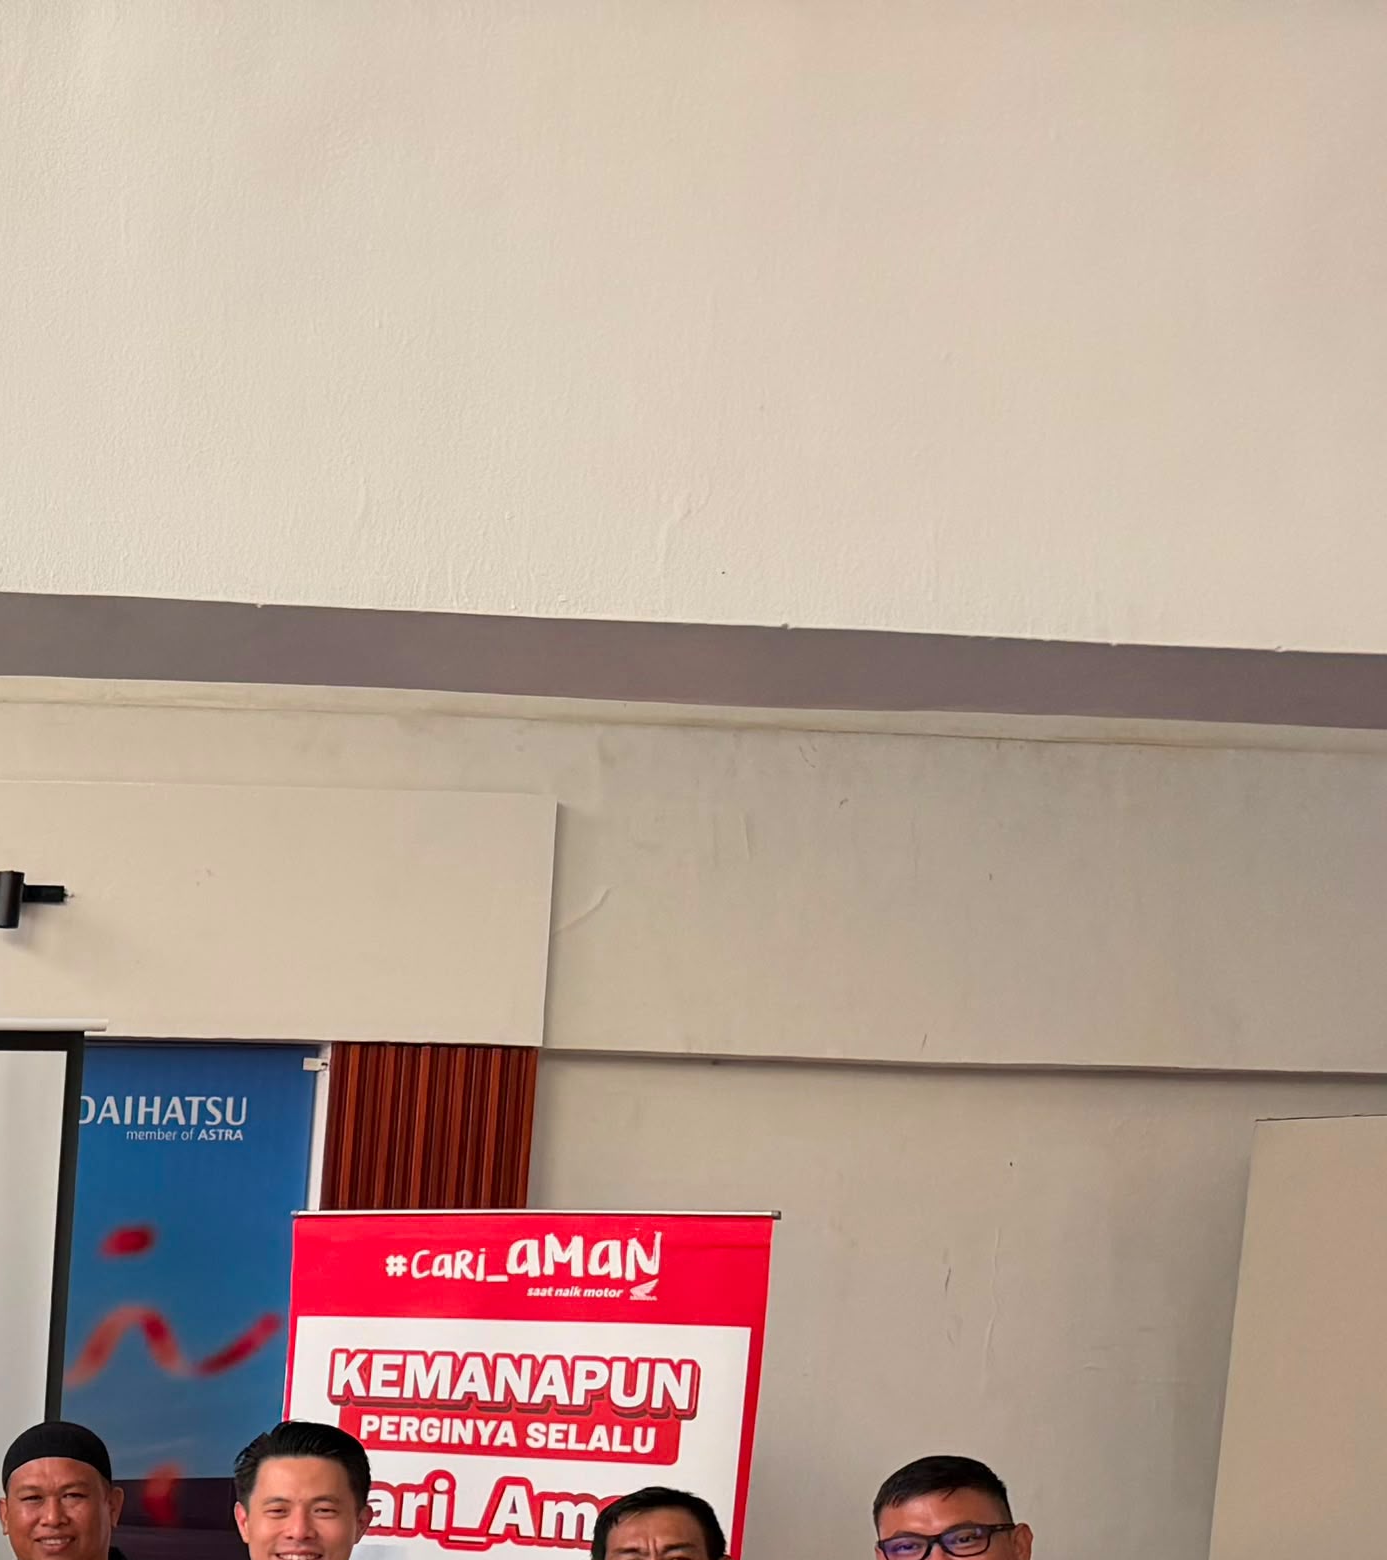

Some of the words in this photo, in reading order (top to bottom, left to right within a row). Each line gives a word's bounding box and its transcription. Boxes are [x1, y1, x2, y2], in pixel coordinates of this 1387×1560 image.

[126, 1128, 177, 1141] member
[181, 1127, 196, 1141] of
[197, 1129, 243, 1141] ASTRA
[526, 1286, 553, 1297] saat
[554, 1286, 581, 1298] naik
[583, 1287, 624, 1298] motor
[330, 1351, 694, 1411] KEMANAPUN
[358, 1415, 518, 1448] PERGINYA
[526, 1422, 657, 1455] SELALU
[369, 1476, 596, 1544] ari_Am
